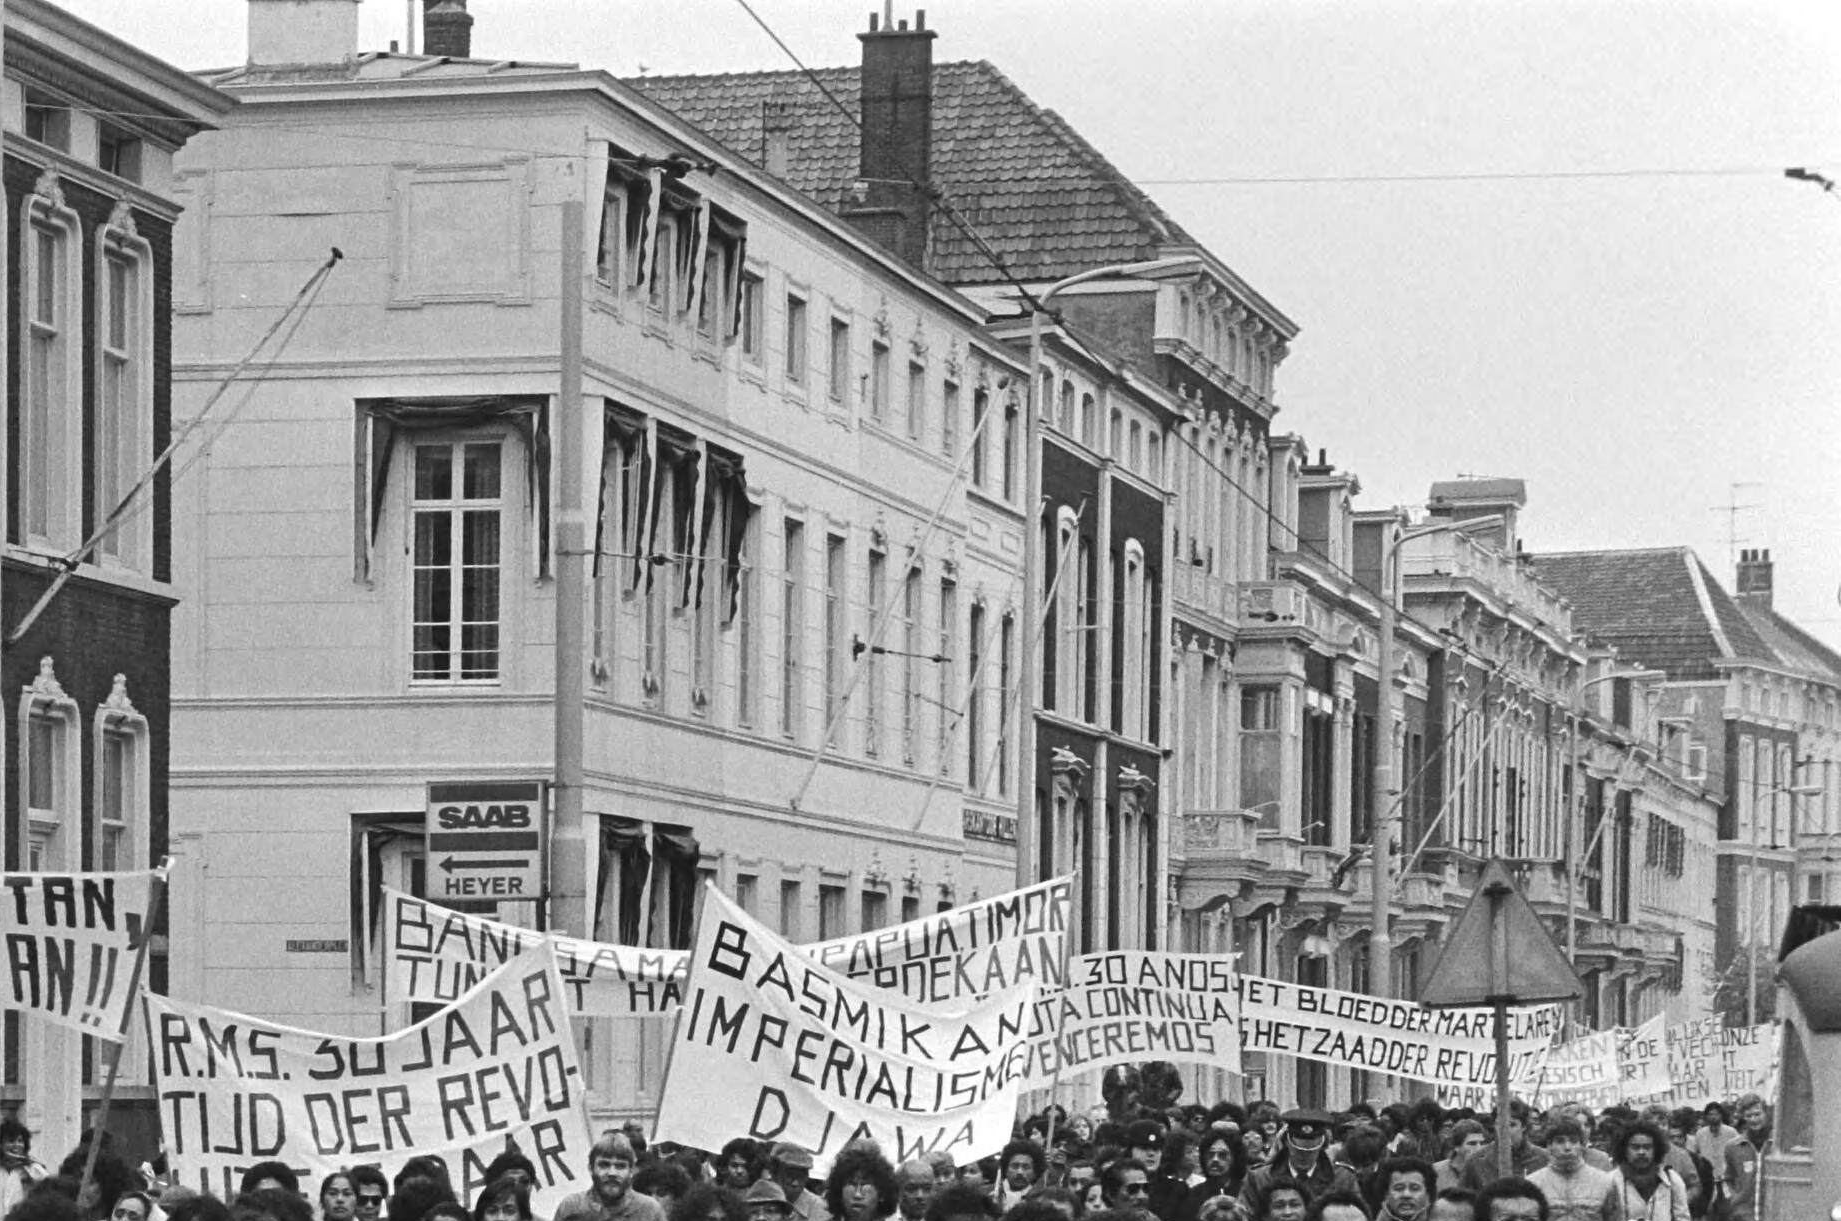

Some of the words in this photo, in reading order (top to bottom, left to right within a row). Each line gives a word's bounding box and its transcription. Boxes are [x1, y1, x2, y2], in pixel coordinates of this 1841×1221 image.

[438, 805, 531, 829] SAAB
[445, 876, 523, 896] HEYER
[708, 920, 1025, 1060] BASMIKAN
[1139, 956, 1229, 993] ANOS
[401, 969, 557, 1072] JAAR
[1086, 986, 1234, 1025] CONTINUA
[687, 988, 1026, 1112] IMPERIALISME
[161, 1091, 287, 1157] TIJD
[304, 1084, 415, 1156] DER
